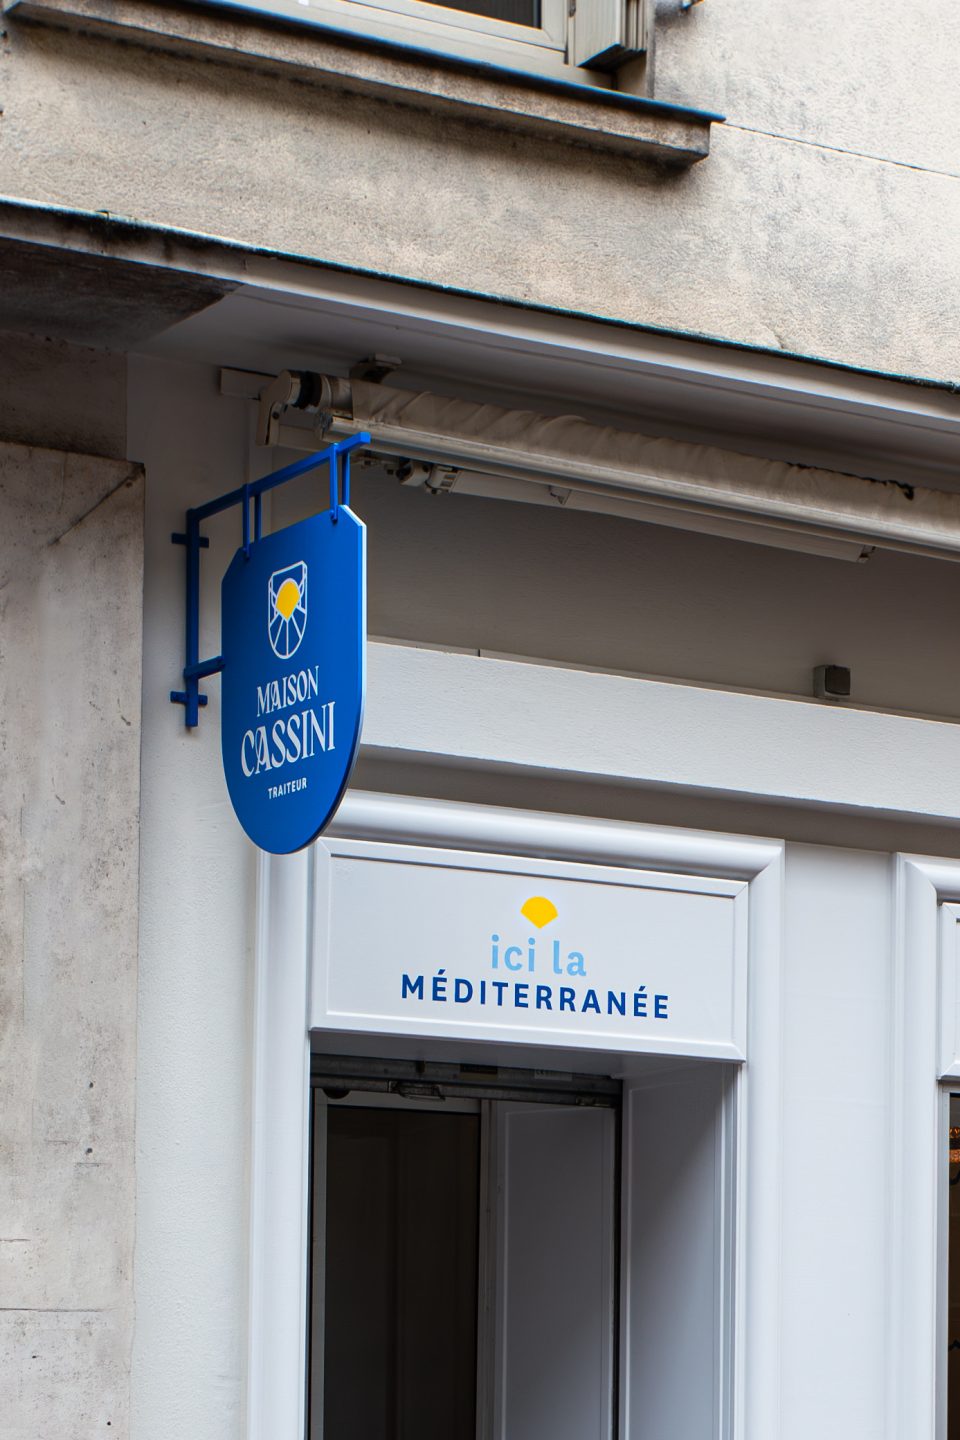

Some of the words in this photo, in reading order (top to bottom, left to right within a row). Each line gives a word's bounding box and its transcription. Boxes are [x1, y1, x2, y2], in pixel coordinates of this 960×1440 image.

[256, 665, 319, 718] MAISON
[240, 701, 336, 778] CASSINI
[267, 777, 308, 800] TRAITEUR
[491, 933, 536, 973] ici
[552, 939, 588, 977] la
[401, 968, 669, 1020] MÉDITERRANÉE
